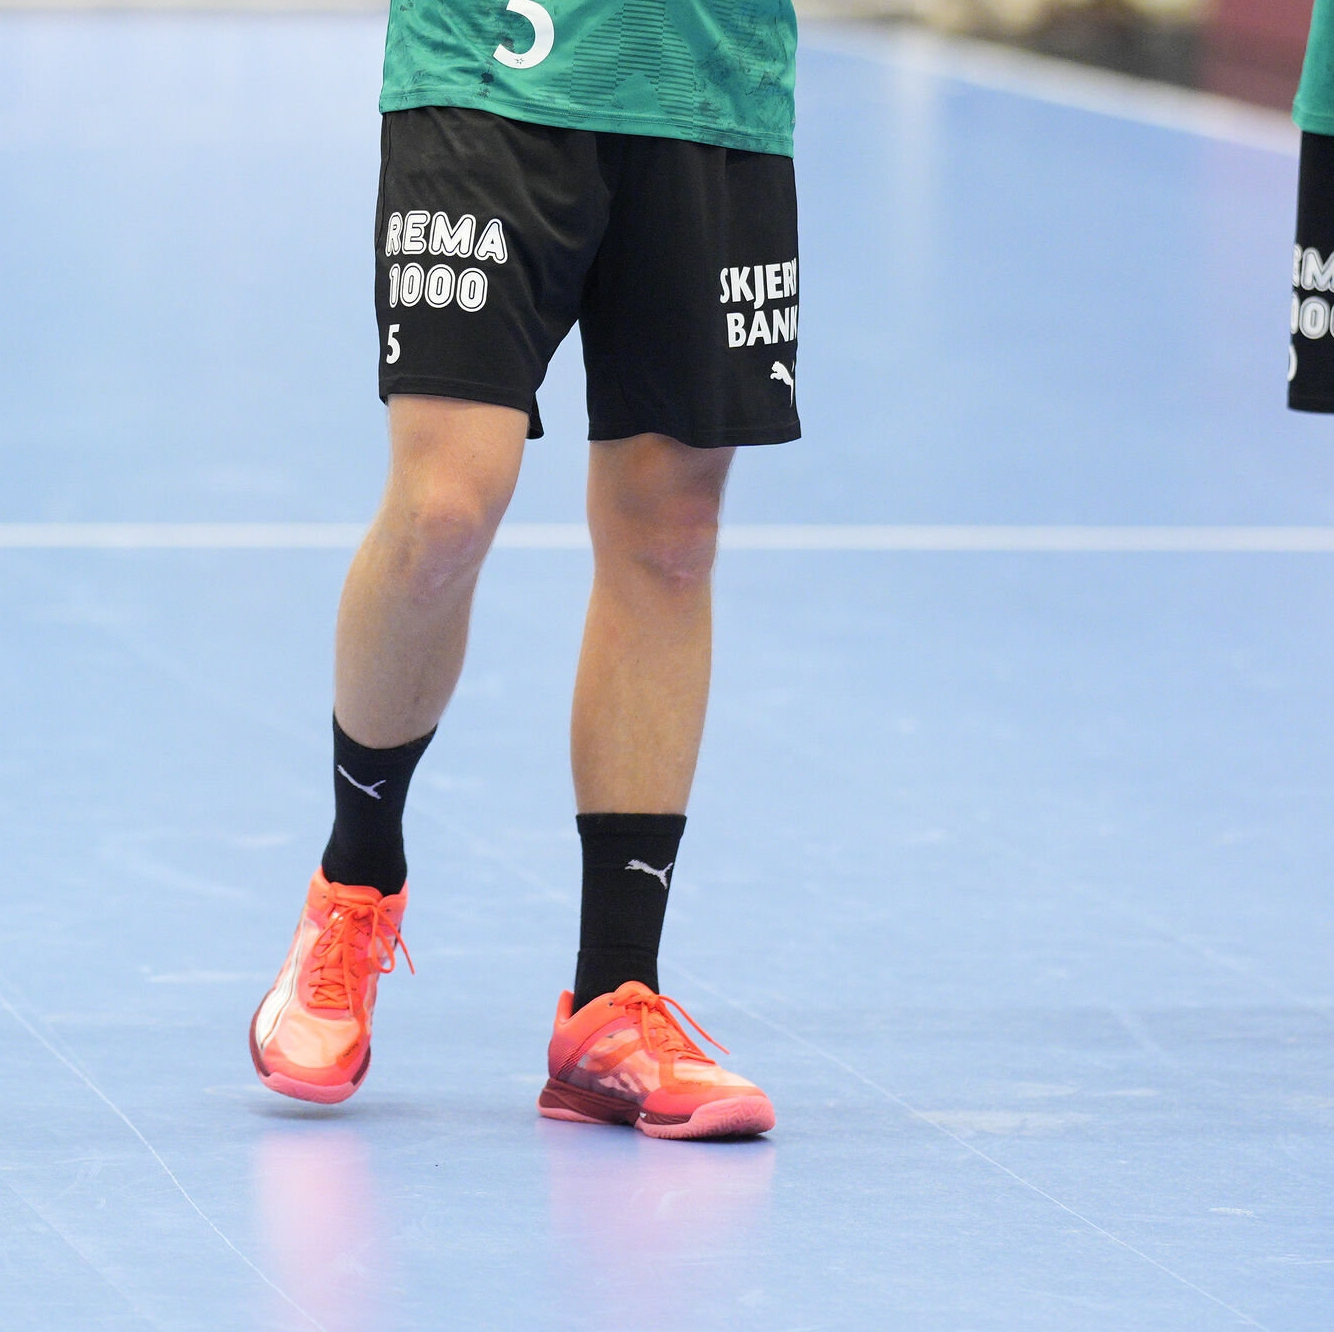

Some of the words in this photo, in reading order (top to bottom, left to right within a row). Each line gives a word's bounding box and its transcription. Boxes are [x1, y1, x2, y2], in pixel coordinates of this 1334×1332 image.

[385, 209, 509, 264] REMA
[389, 261, 489, 313] 1000
[386, 323, 401, 364] 5
